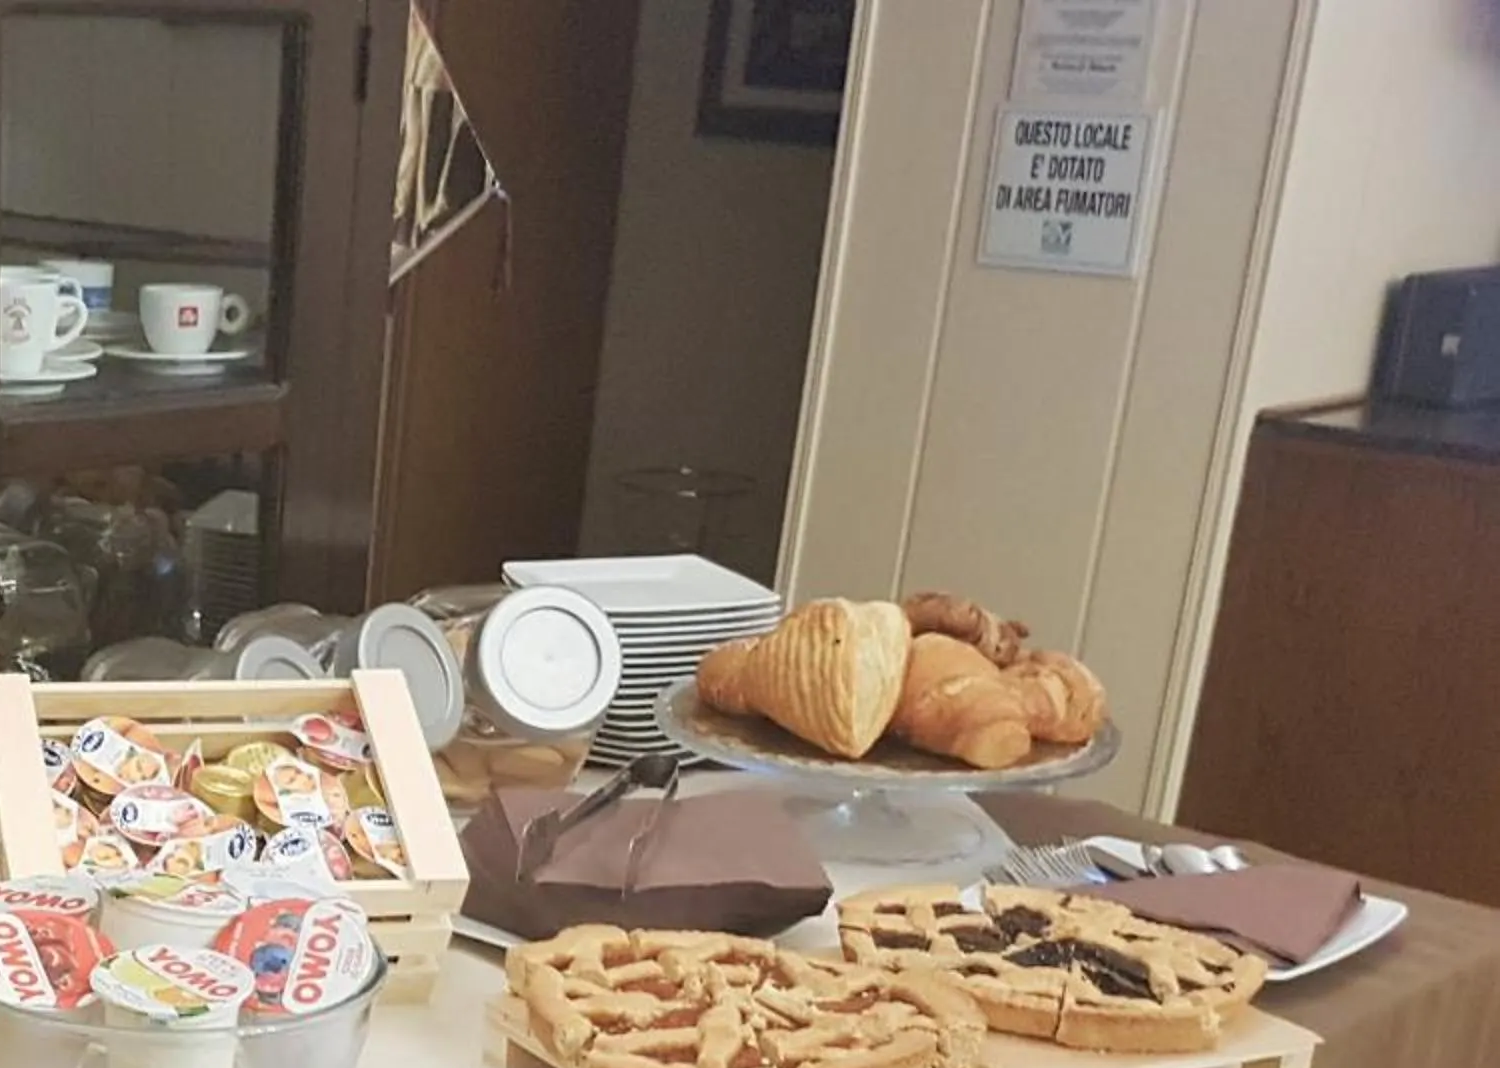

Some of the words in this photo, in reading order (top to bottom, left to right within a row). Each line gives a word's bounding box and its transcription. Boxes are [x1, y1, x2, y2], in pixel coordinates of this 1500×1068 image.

[1015, 120, 1072, 147] QUESTO
[1074, 123, 1132, 150] LOCALE
[1047, 155, 1106, 183] DOTATO
[996, 185, 1012, 211] DI
[1012, 186, 1051, 212] AREA
[1055, 188, 1132, 218] FUMATORI
[148, 947, 239, 997] YOMO
[291, 913, 343, 1005] YOMO
